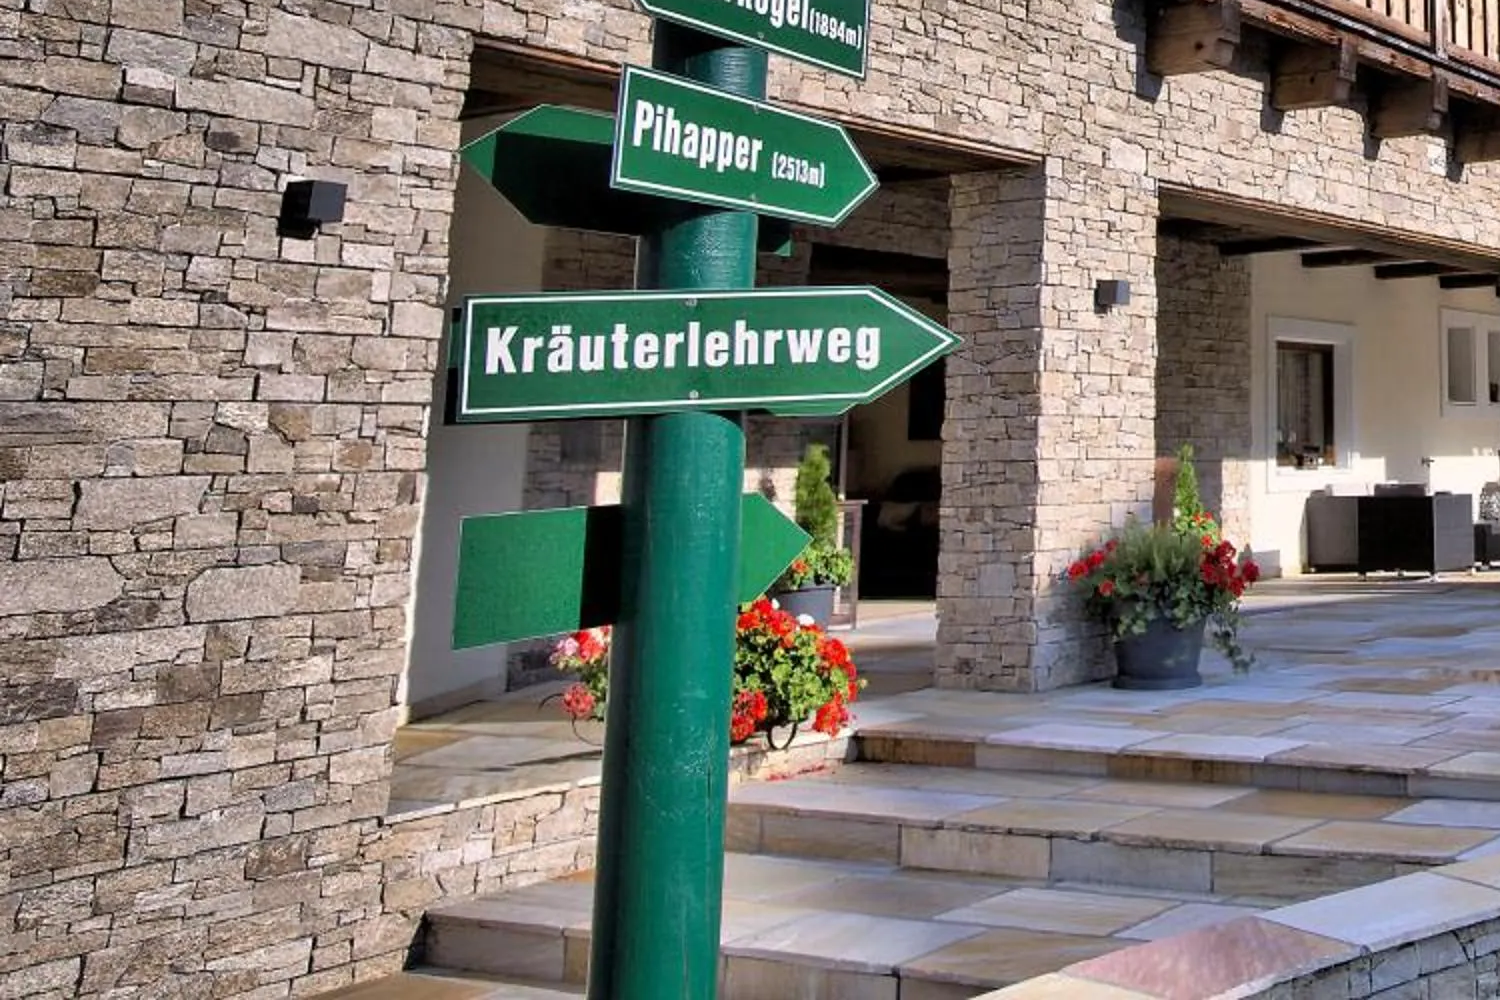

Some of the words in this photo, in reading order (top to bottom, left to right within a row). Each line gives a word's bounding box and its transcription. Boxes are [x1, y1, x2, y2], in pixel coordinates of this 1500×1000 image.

[809, 7, 863, 50] (1894m)
[632, 99, 763, 173] Pihapper
[771, 151, 825, 189] (2513m)
[484, 319, 882, 375] Kräuterlehrweg
